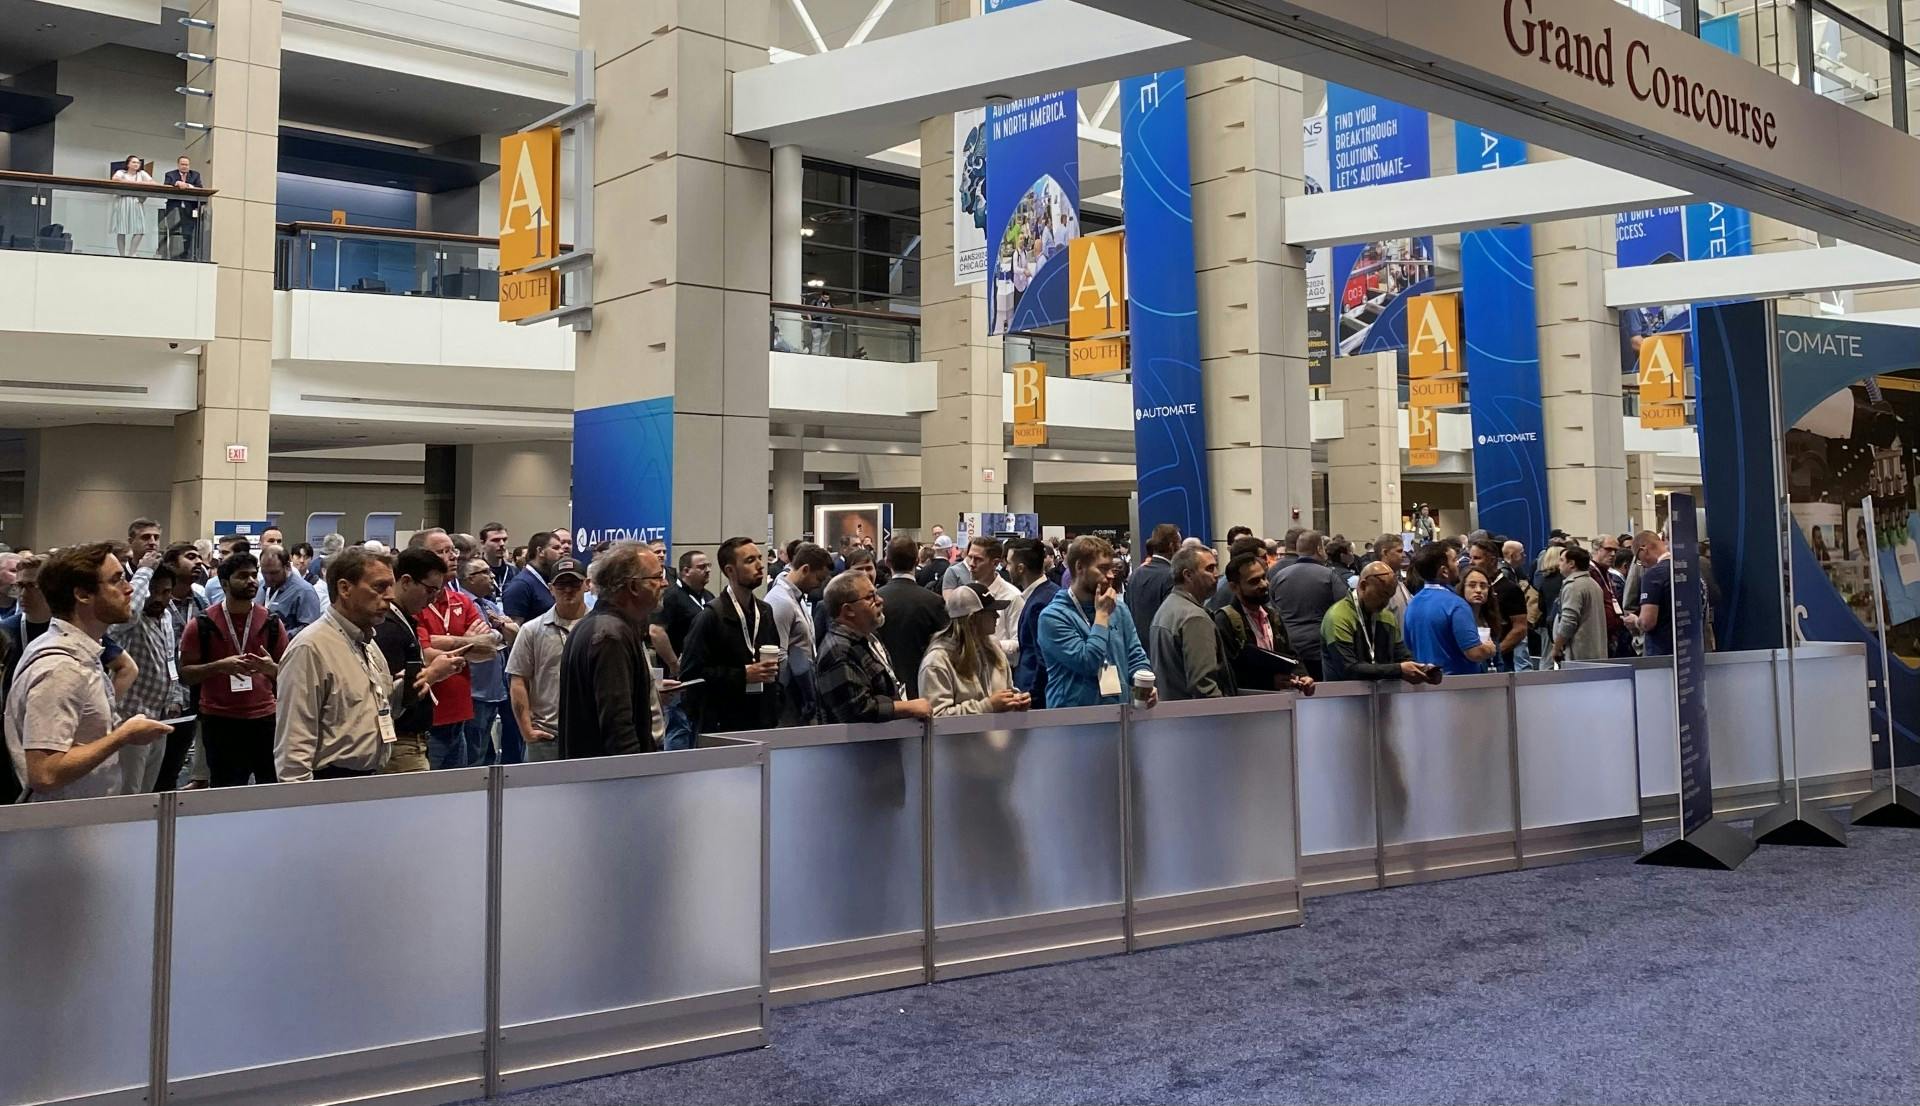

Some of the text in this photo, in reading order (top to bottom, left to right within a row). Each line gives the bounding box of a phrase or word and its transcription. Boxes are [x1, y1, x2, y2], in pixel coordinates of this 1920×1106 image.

[1503, 0, 1777, 149] Grand Concourse
[1141, 72, 1158, 113] E
[993, 100, 1066, 140] IN NORTH AMERICA.
[1335, 104, 1377, 131] FIND YOUR
[1335, 119, 1398, 151] BREAKTHROUGH
[1335, 144, 1382, 170] SOLUTIONS.
[1480, 128, 1500, 169] AT
[1336, 169, 1358, 189] LET'S
[501, 276, 548, 303] SOUTH
[1072, 344, 1119, 363] SOUTH
[1412, 382, 1455, 397] SOUTH
[1142, 403, 1197, 419] AUTOMATE
[1642, 408, 1681, 420] SOUTH
[1015, 428, 1042, 438] NORTH
[1487, 432, 1537, 443] AUTOMATE
[228, 448, 245, 459] EXIT
[589, 527, 665, 548] AUTOMATE
